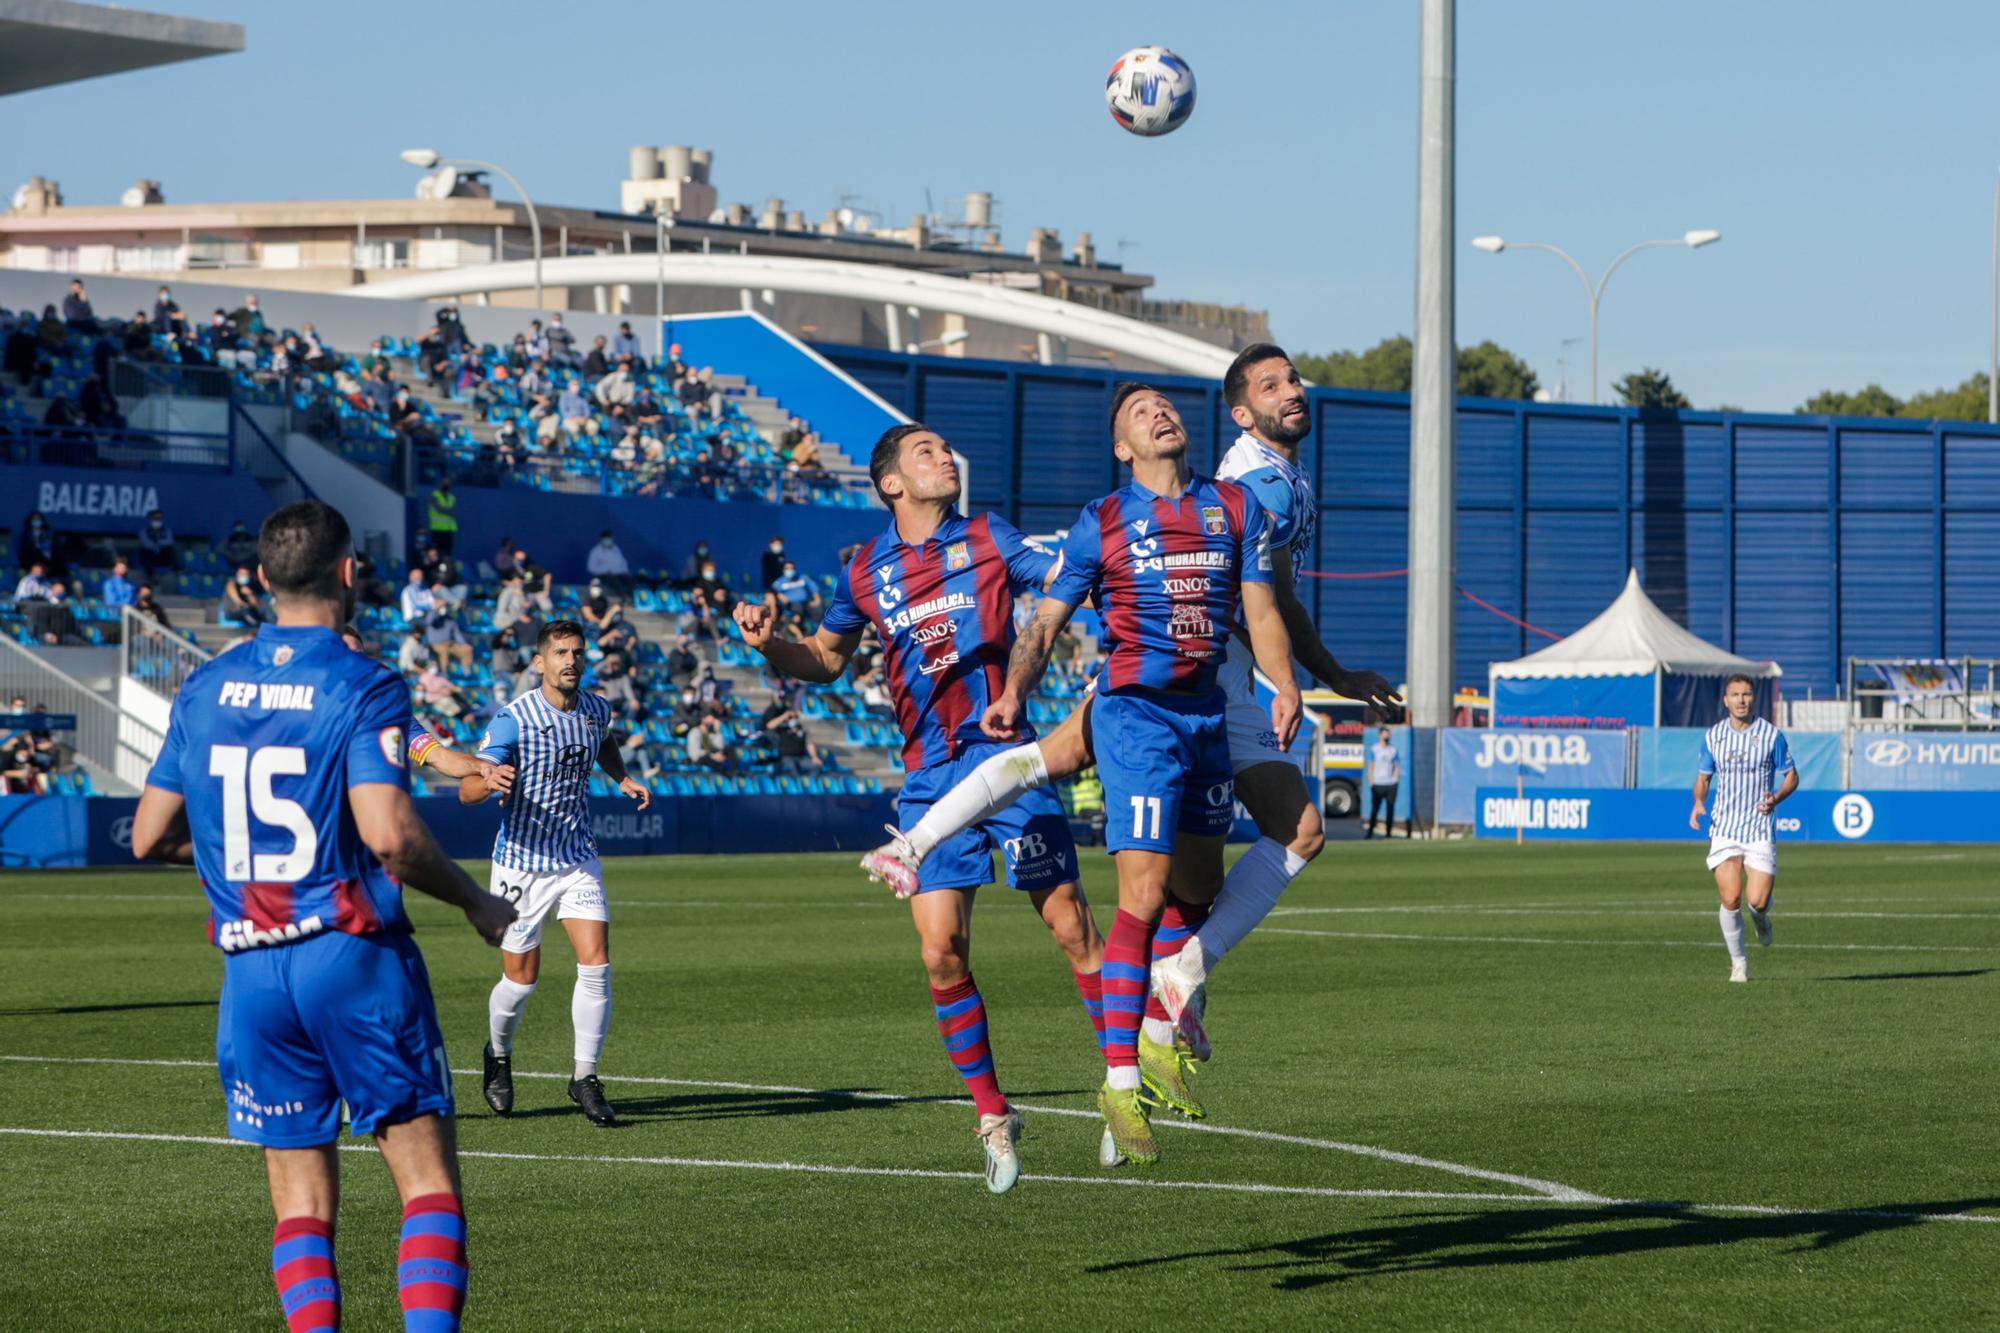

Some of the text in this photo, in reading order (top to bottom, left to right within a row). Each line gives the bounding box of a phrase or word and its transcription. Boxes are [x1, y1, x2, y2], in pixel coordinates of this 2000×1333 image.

[1162, 577, 1211, 594] XINO'S
[910, 619, 958, 645] XINO'S
[218, 681, 315, 711] PEP VIDAL
[209, 744, 317, 882] 15
[593, 813, 664, 839] AGUILAR
[1131, 796, 1161, 840] 11
[1484, 798, 1545, 829] GOMILA
